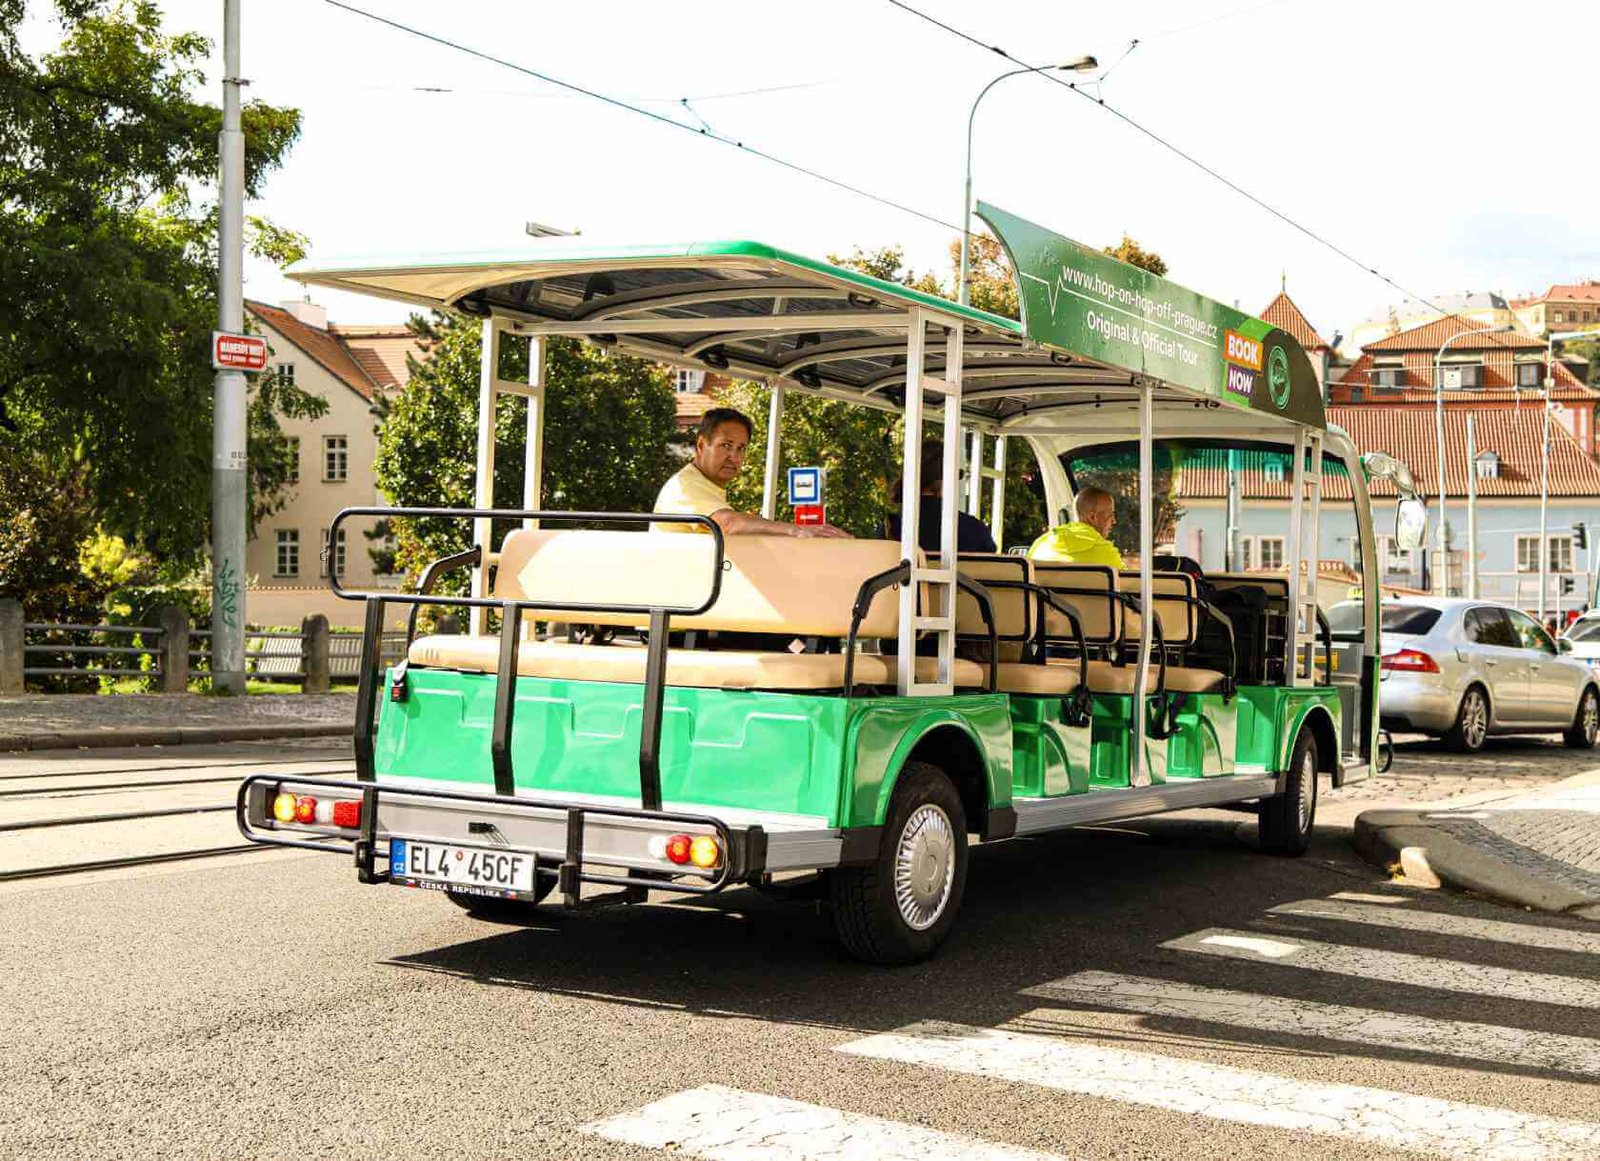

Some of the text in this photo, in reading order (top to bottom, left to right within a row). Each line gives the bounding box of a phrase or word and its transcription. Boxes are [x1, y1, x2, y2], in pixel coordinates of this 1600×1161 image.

[1062, 265, 1218, 339] www.hop-on-hop-off-prague.cz
[1087, 310, 1199, 366] Original & Official Tour
[1228, 334, 1258, 366] BOOK
[1229, 369, 1253, 393] NOW
[393, 862, 405, 872] CZ
[410, 845, 524, 885] EL4 45CF
